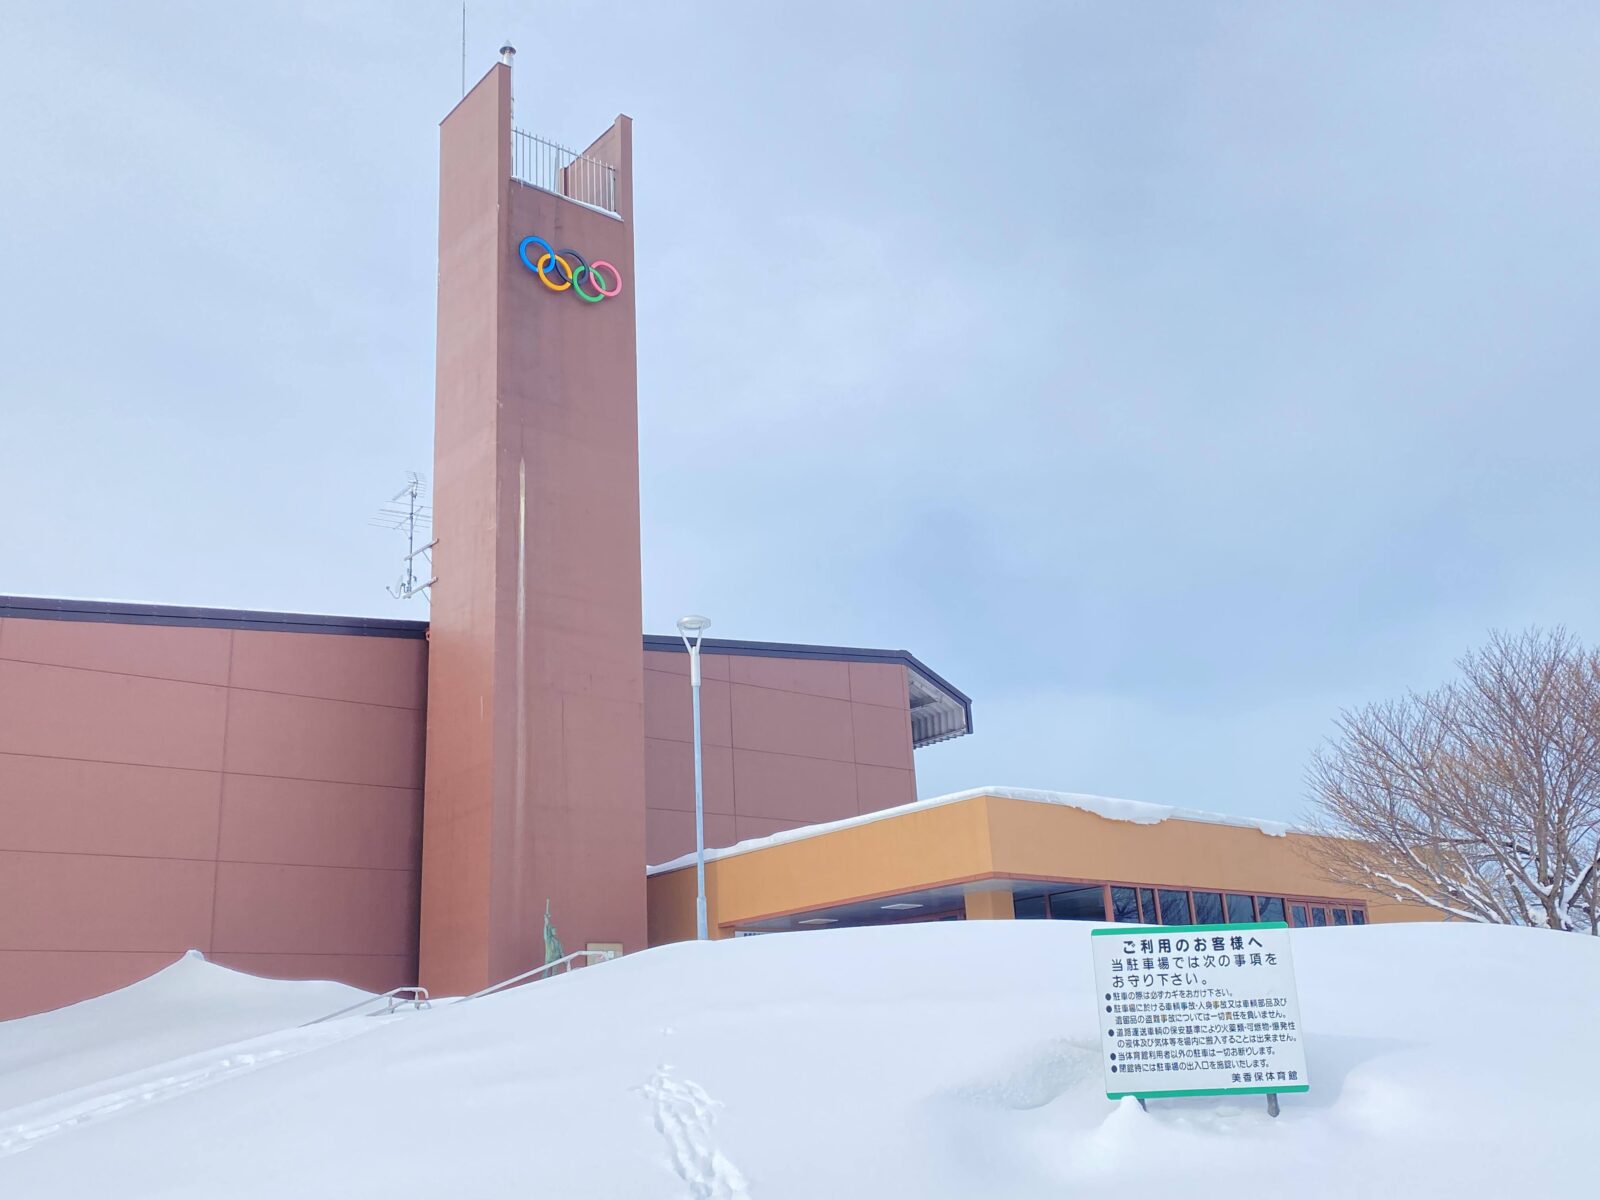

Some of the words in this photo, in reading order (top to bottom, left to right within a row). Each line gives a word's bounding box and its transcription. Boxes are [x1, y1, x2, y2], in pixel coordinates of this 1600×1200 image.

[1123, 936, 1263, 954] ご利用のお客様へ
[1112, 952, 1278, 972] 当駐車場では次の事項を
[1112, 972, 1207, 989] お守り下さい。
[1231, 1070, 1298, 1083] 美香保体育館
